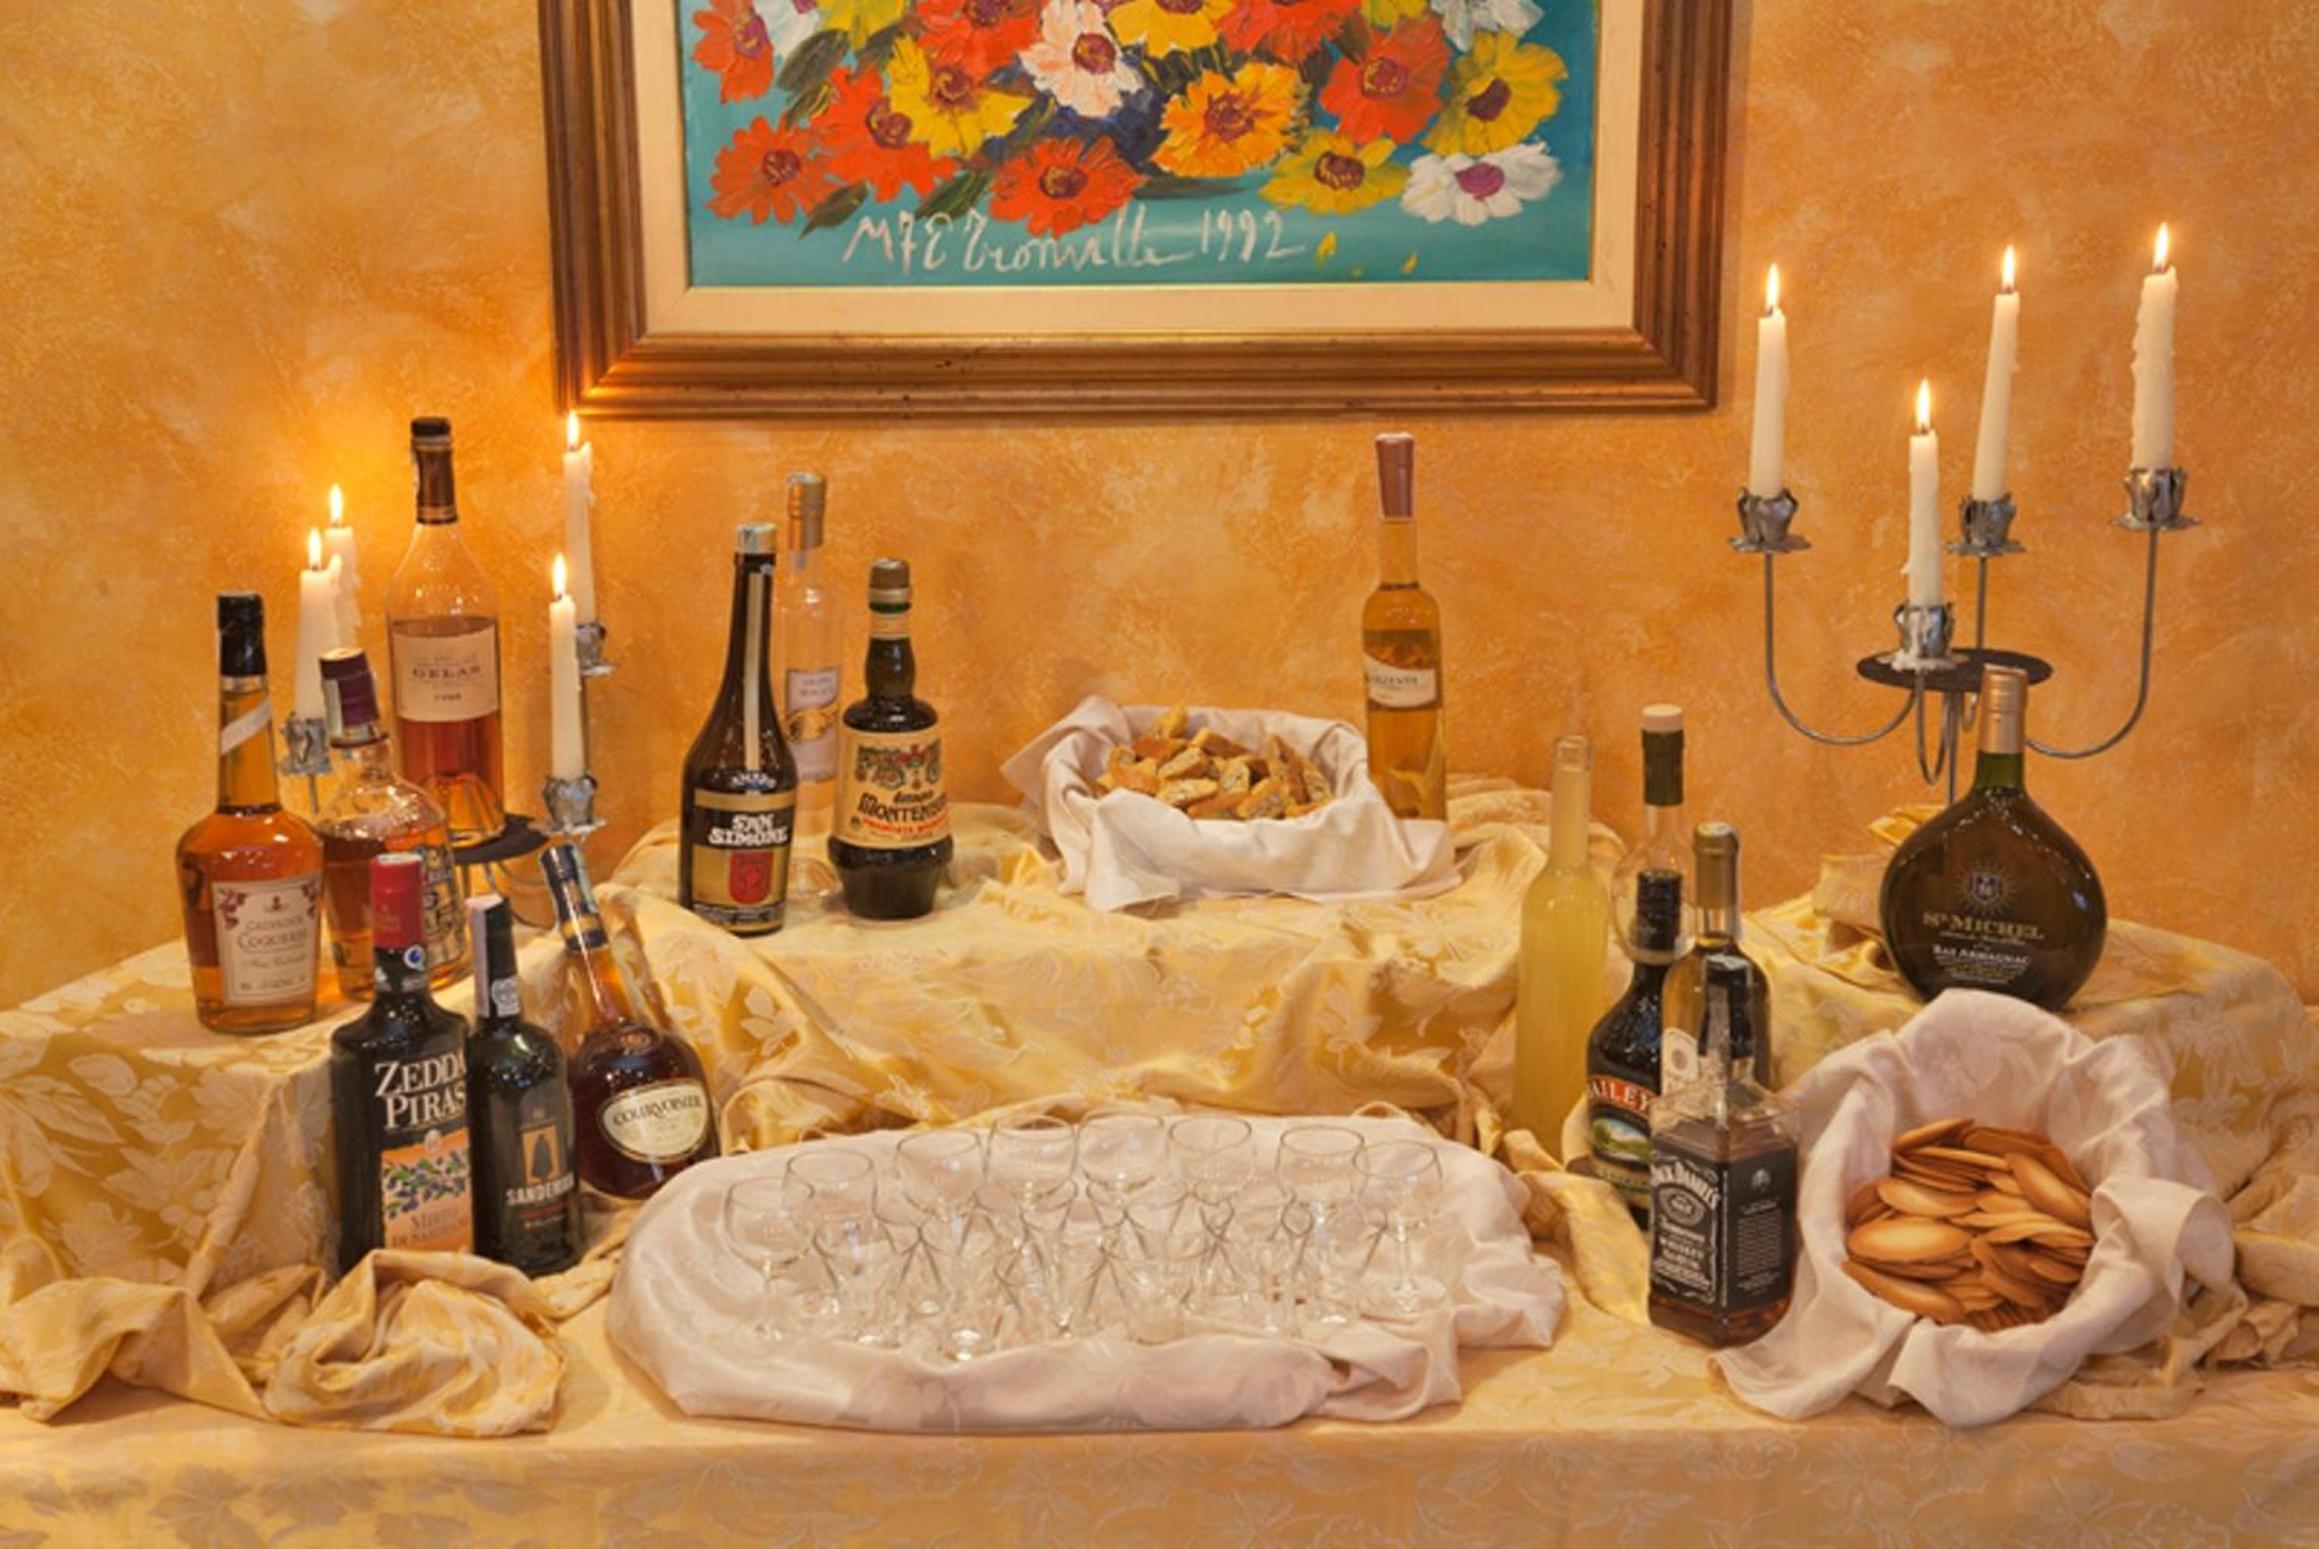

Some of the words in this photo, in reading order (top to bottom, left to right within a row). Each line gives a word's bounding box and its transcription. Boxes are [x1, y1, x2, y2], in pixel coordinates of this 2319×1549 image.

[1201, 209, 1306, 264] 1992
[731, 812, 776, 834] SAN
[707, 824, 790, 847] SIMONE
[1949, 914, 2046, 940] MICHEL
